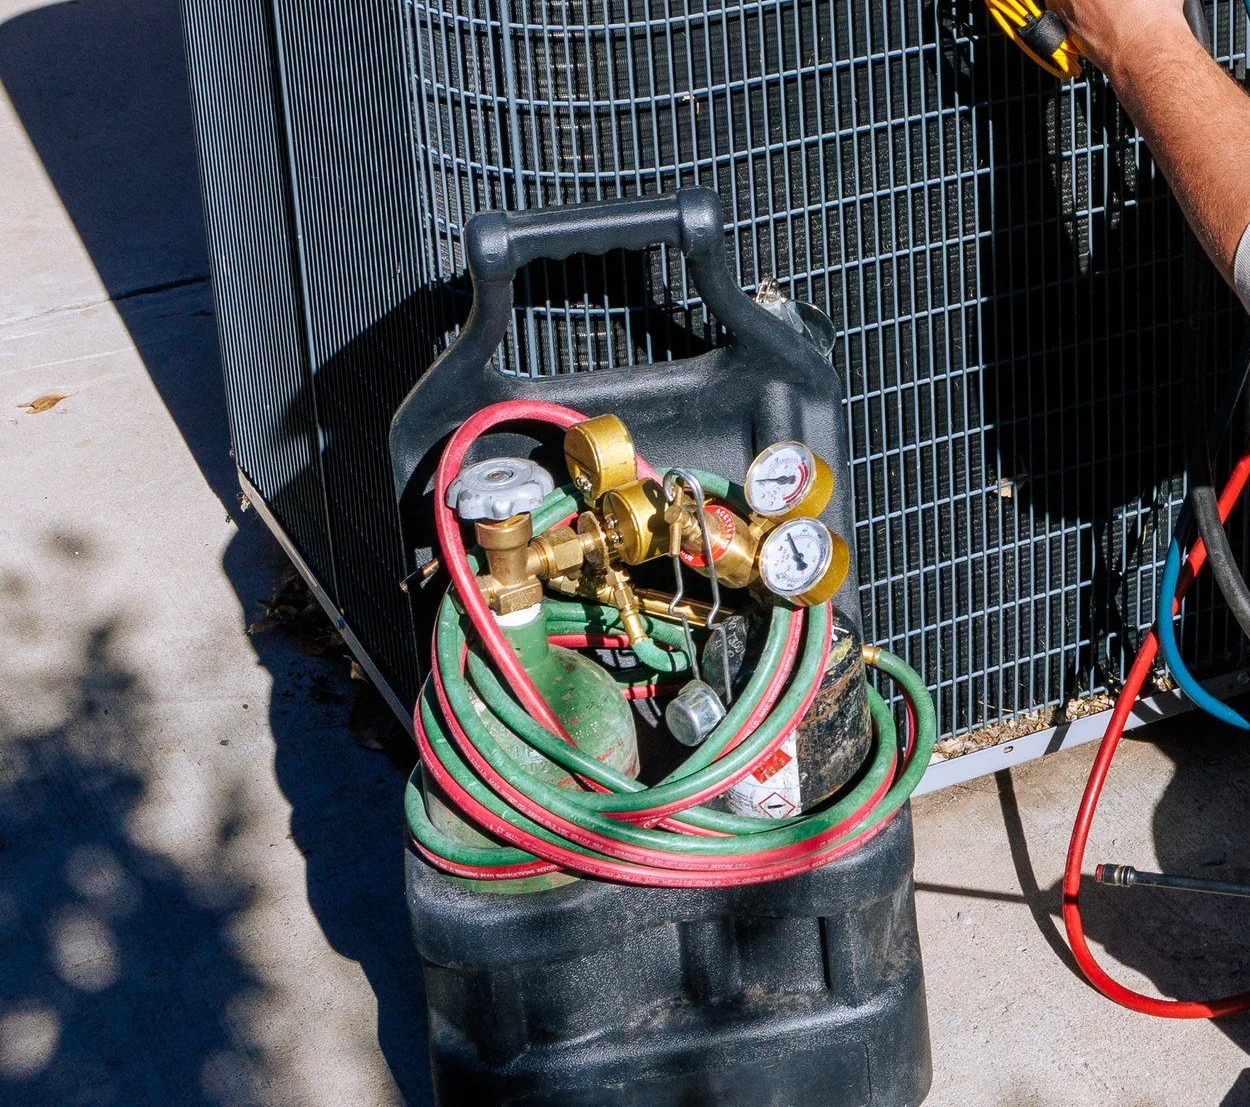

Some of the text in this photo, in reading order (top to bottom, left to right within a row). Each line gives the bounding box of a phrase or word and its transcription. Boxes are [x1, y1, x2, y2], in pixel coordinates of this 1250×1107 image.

[614, 849, 644, 862] WARNING
[647, 857, 663, 865] READ
[664, 860, 708, 870] INSTRUCTIONS
[496, 869, 535, 878] INSTRUCTIONS
